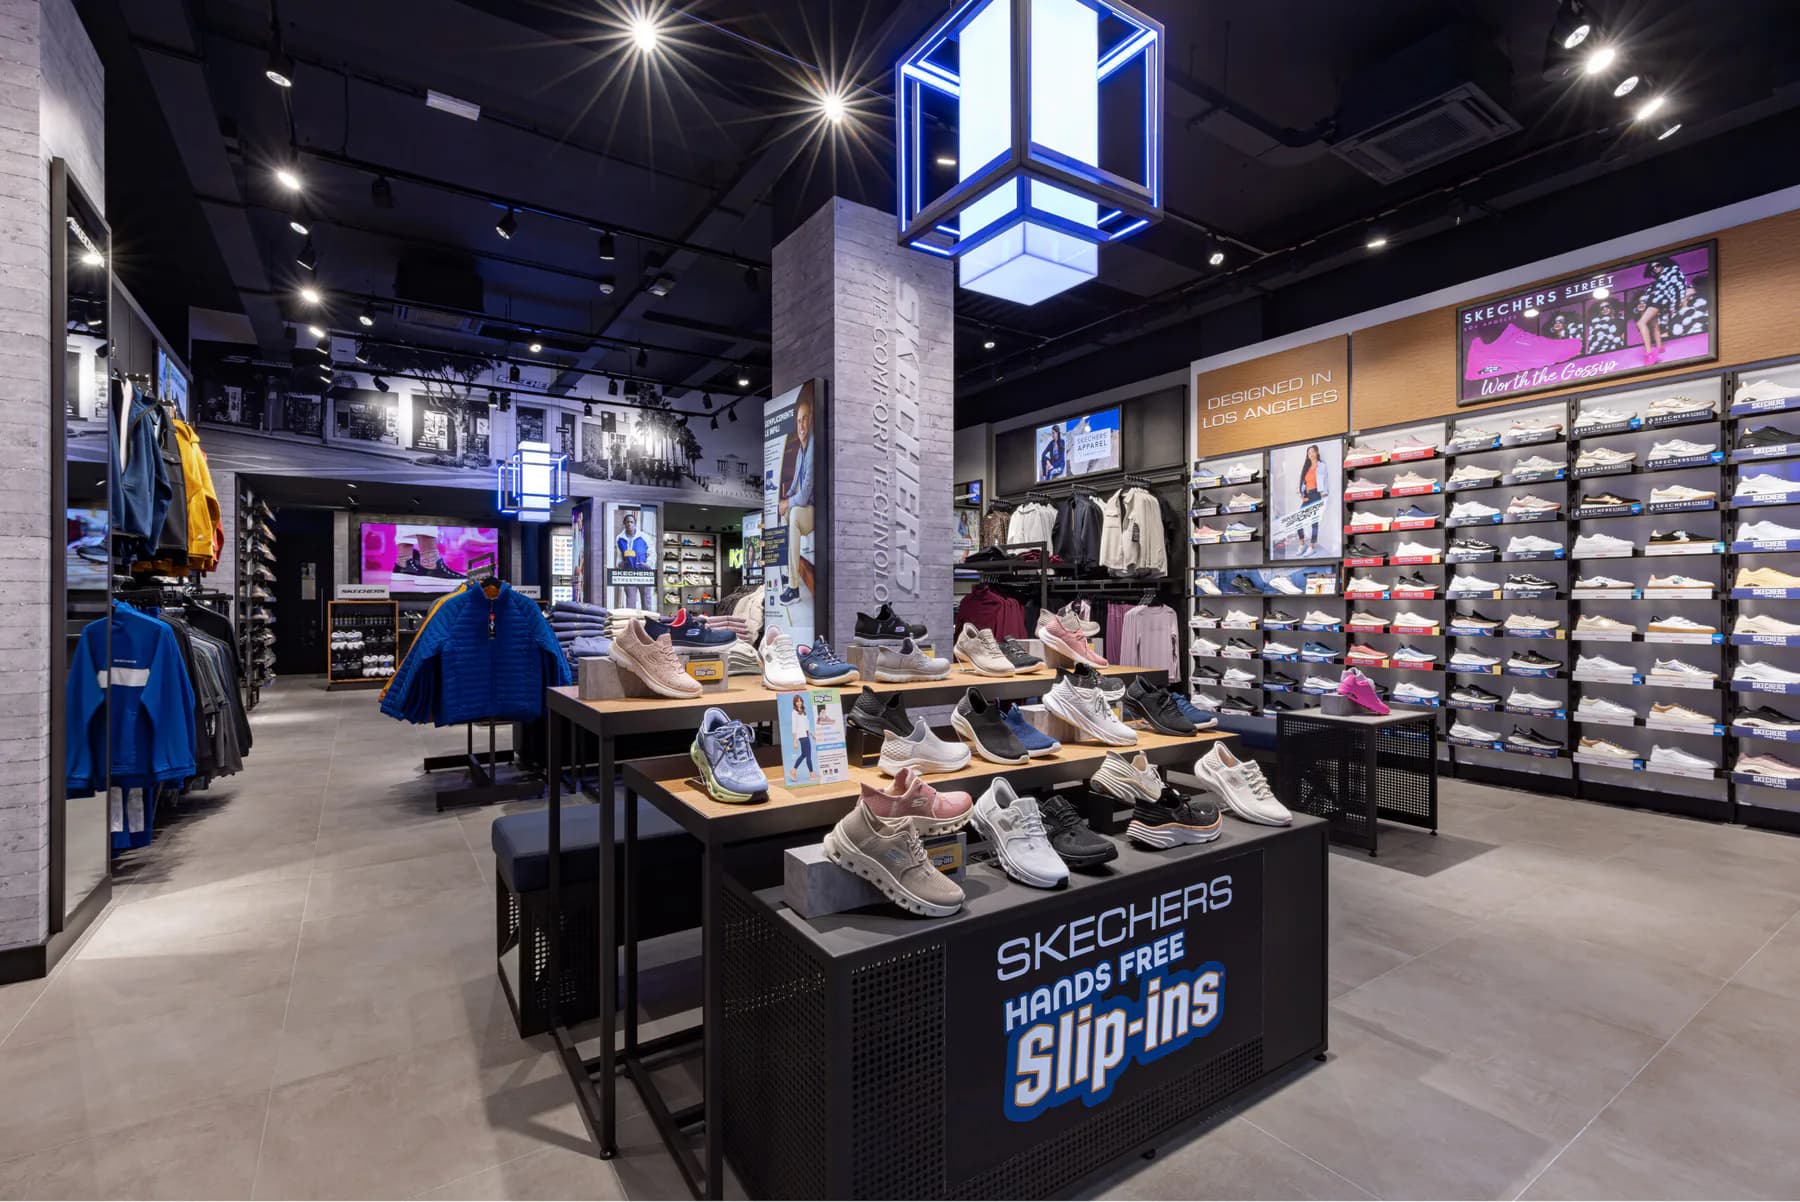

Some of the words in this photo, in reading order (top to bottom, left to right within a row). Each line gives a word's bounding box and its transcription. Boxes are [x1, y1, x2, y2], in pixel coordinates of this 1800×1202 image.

[873, 273, 889, 324] THE
[1464, 291, 1557, 324] SKECHERS
[1565, 275, 1614, 296] STREET
[873, 327, 889, 459] COMFORT
[1208, 377, 1304, 410] DESIGNED
[1311, 370, 1332, 386] IN
[1481, 370, 1530, 395] Worth
[1532, 367, 1558, 384] the
[1561, 360, 1618, 380] Gossip
[1203, 411, 1238, 429] LOS
[1244, 389, 1338, 420] ANGELES
[896, 276, 920, 599] SKECHERS
[1077, 432, 1108, 445] SKECHERS
[1077, 440, 1107, 452] APPAREL
[997, 875, 1233, 981] SKECHERS
[1006, 962, 1111, 1032] HANDS
[1120, 932, 1184, 982] FREE
[1014, 971, 1220, 1107] Slip-ins
